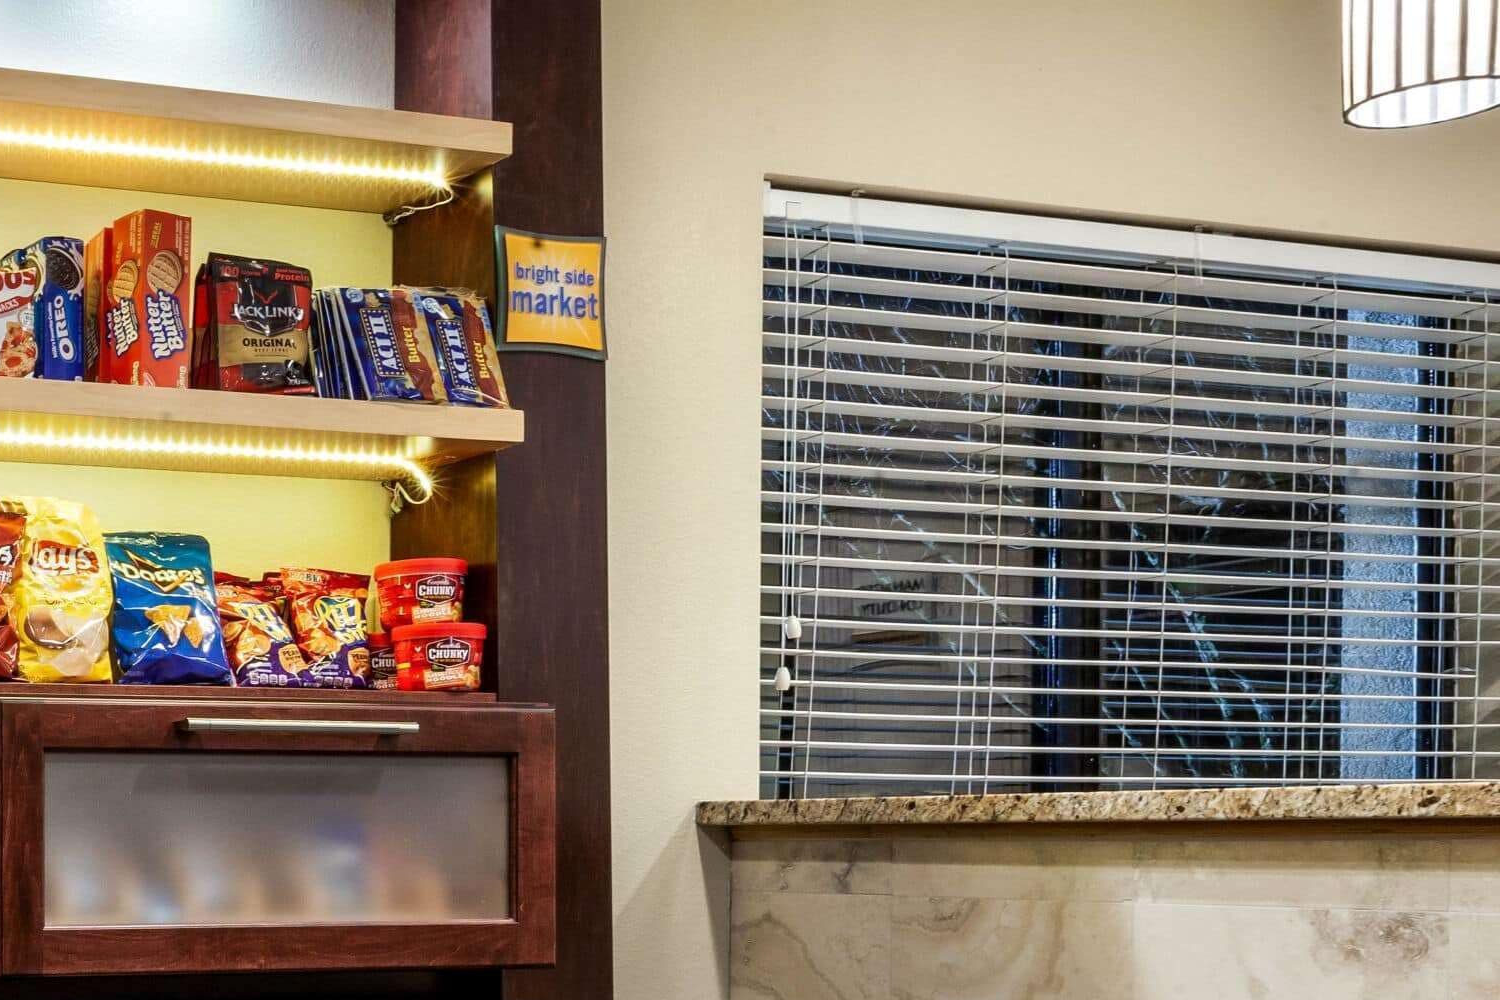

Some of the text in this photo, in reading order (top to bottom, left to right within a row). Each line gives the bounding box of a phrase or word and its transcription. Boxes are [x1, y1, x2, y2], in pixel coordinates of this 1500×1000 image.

[515, 262, 594, 286] bright side
[120, 300, 138, 345] Butter
[158, 290, 184, 350] Butter
[512, 287, 598, 319] market
[53, 295, 75, 361] OREO
[112, 308, 129, 356] Nutter
[147, 296, 171, 359] Nutter
[368, 315, 399, 369] ACT II
[402, 325, 421, 363] Butter
[444, 328, 472, 385] ACT II
[473, 340, 491, 380] Butter
[418, 584, 456, 597] CHUNKY
[428, 648, 469, 660] CHUNKY
